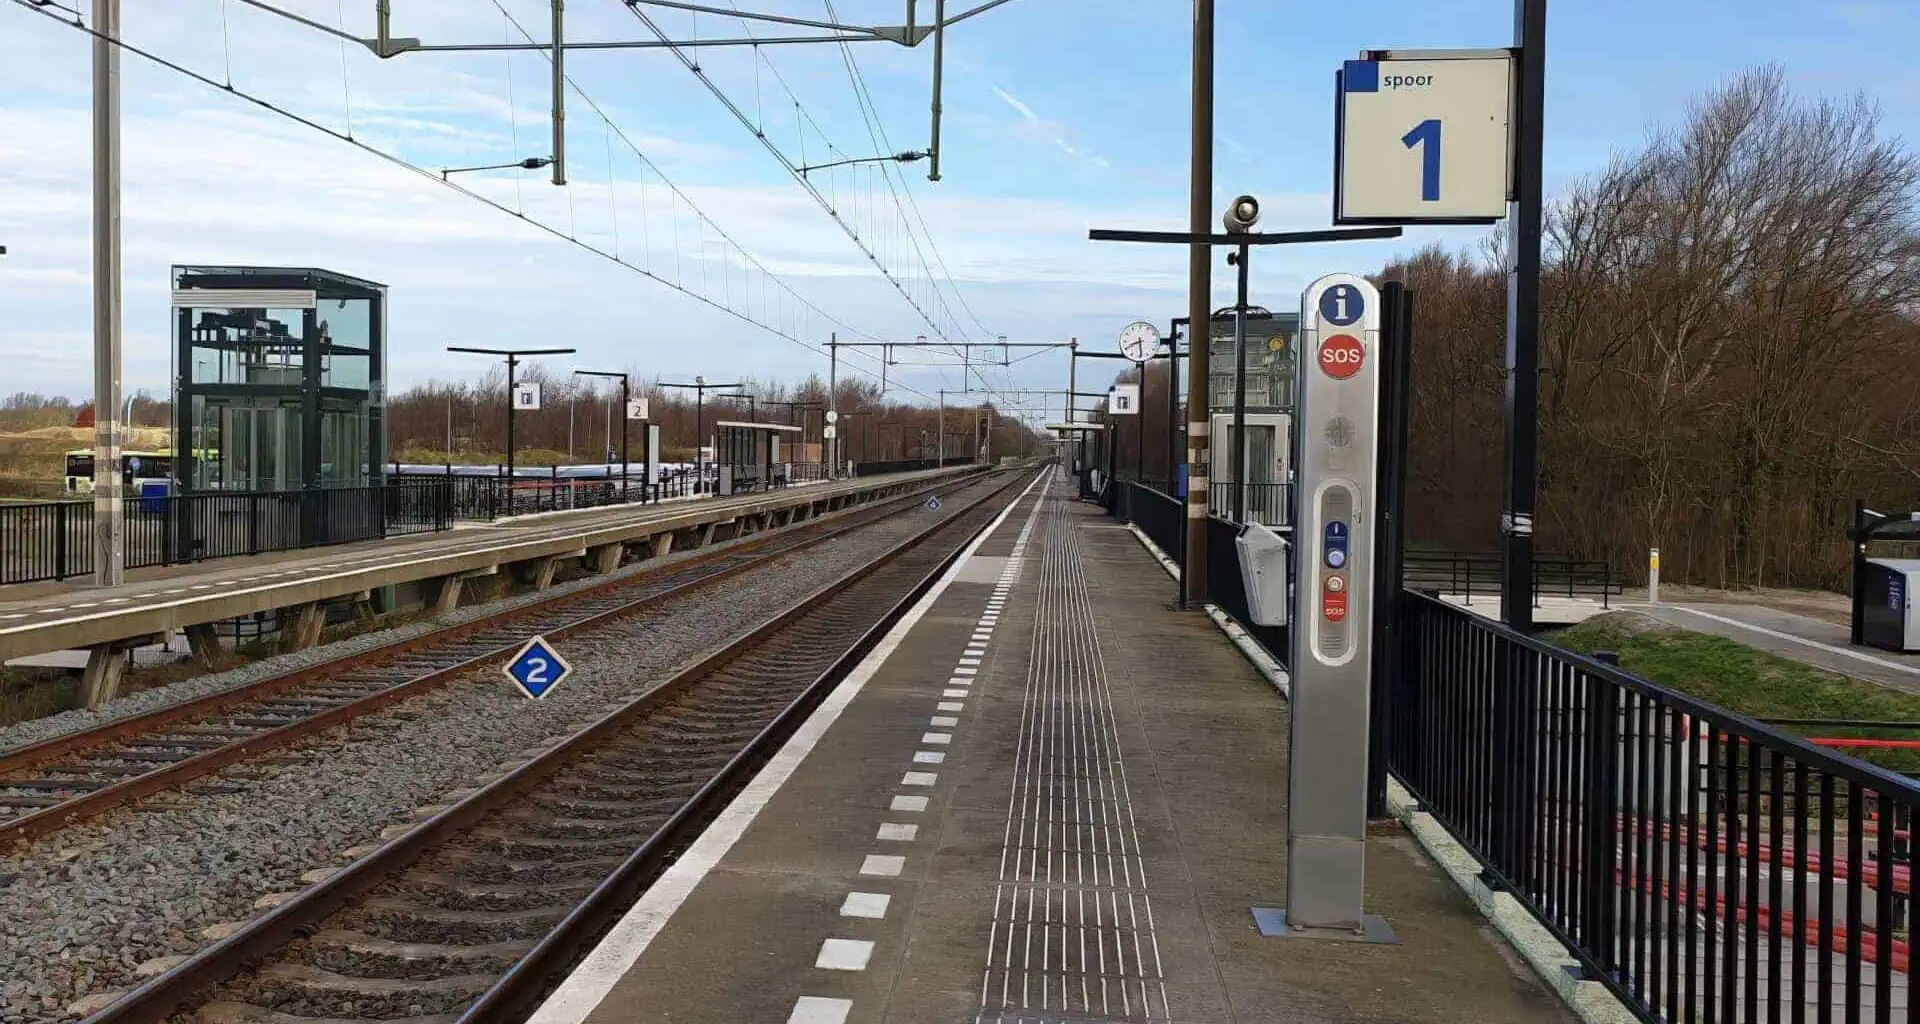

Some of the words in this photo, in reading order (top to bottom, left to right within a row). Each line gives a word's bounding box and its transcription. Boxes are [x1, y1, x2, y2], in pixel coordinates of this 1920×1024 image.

[1384, 75, 1433, 89] spoor
[1401, 119, 1441, 201] 1
[1322, 348, 1360, 363] SOS
[526, 658, 548, 682] 2
